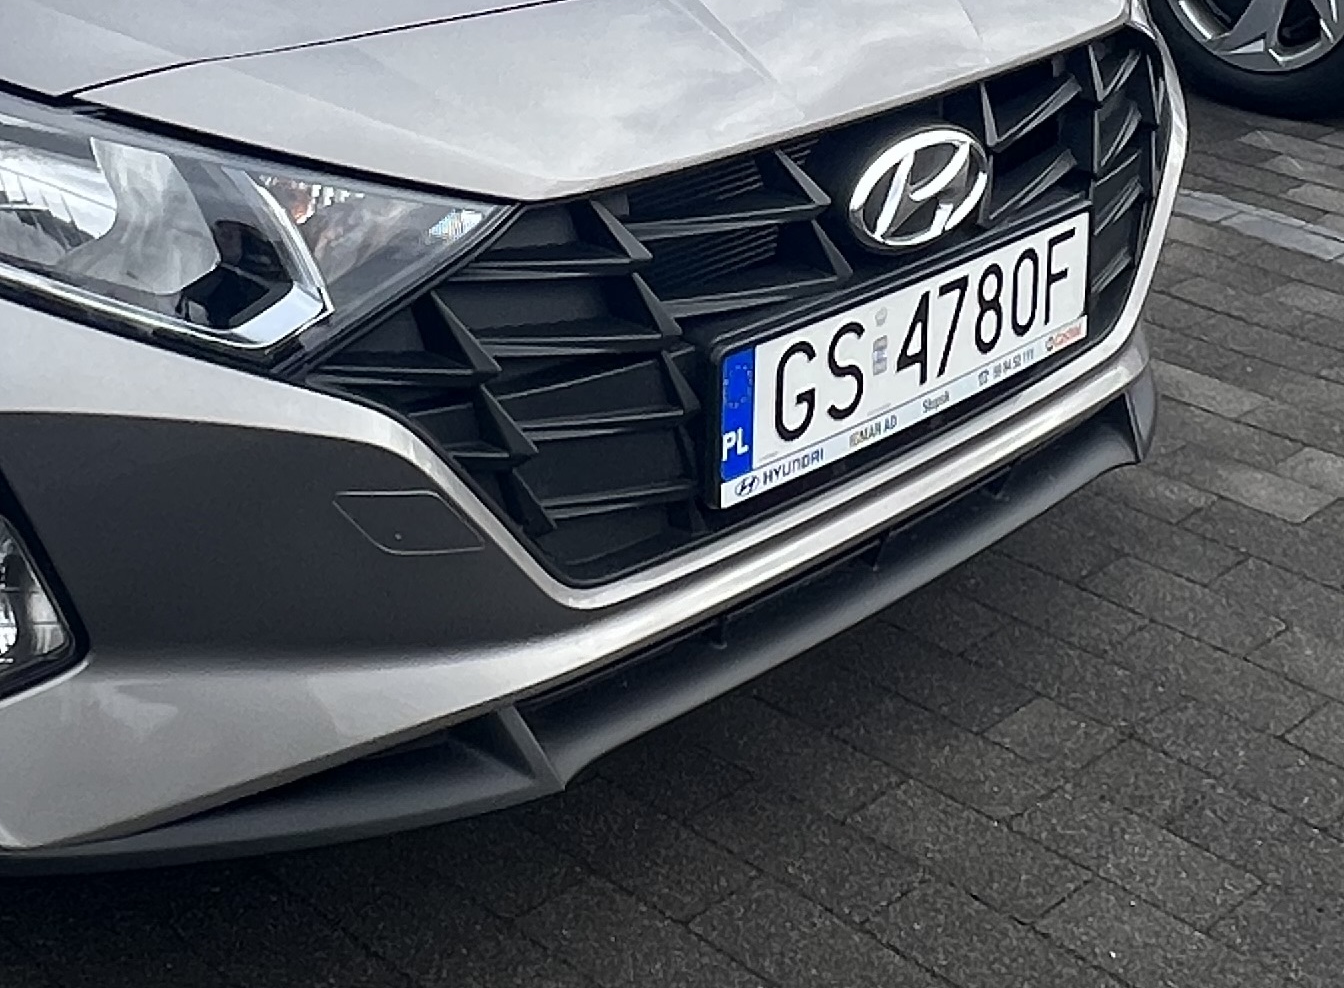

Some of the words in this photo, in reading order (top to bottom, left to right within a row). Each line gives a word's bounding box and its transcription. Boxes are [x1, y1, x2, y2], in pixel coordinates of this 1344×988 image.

[775, 322, 865, 442] GS
[895, 227, 1077, 387] 4780F
[722, 427, 749, 461] PL
